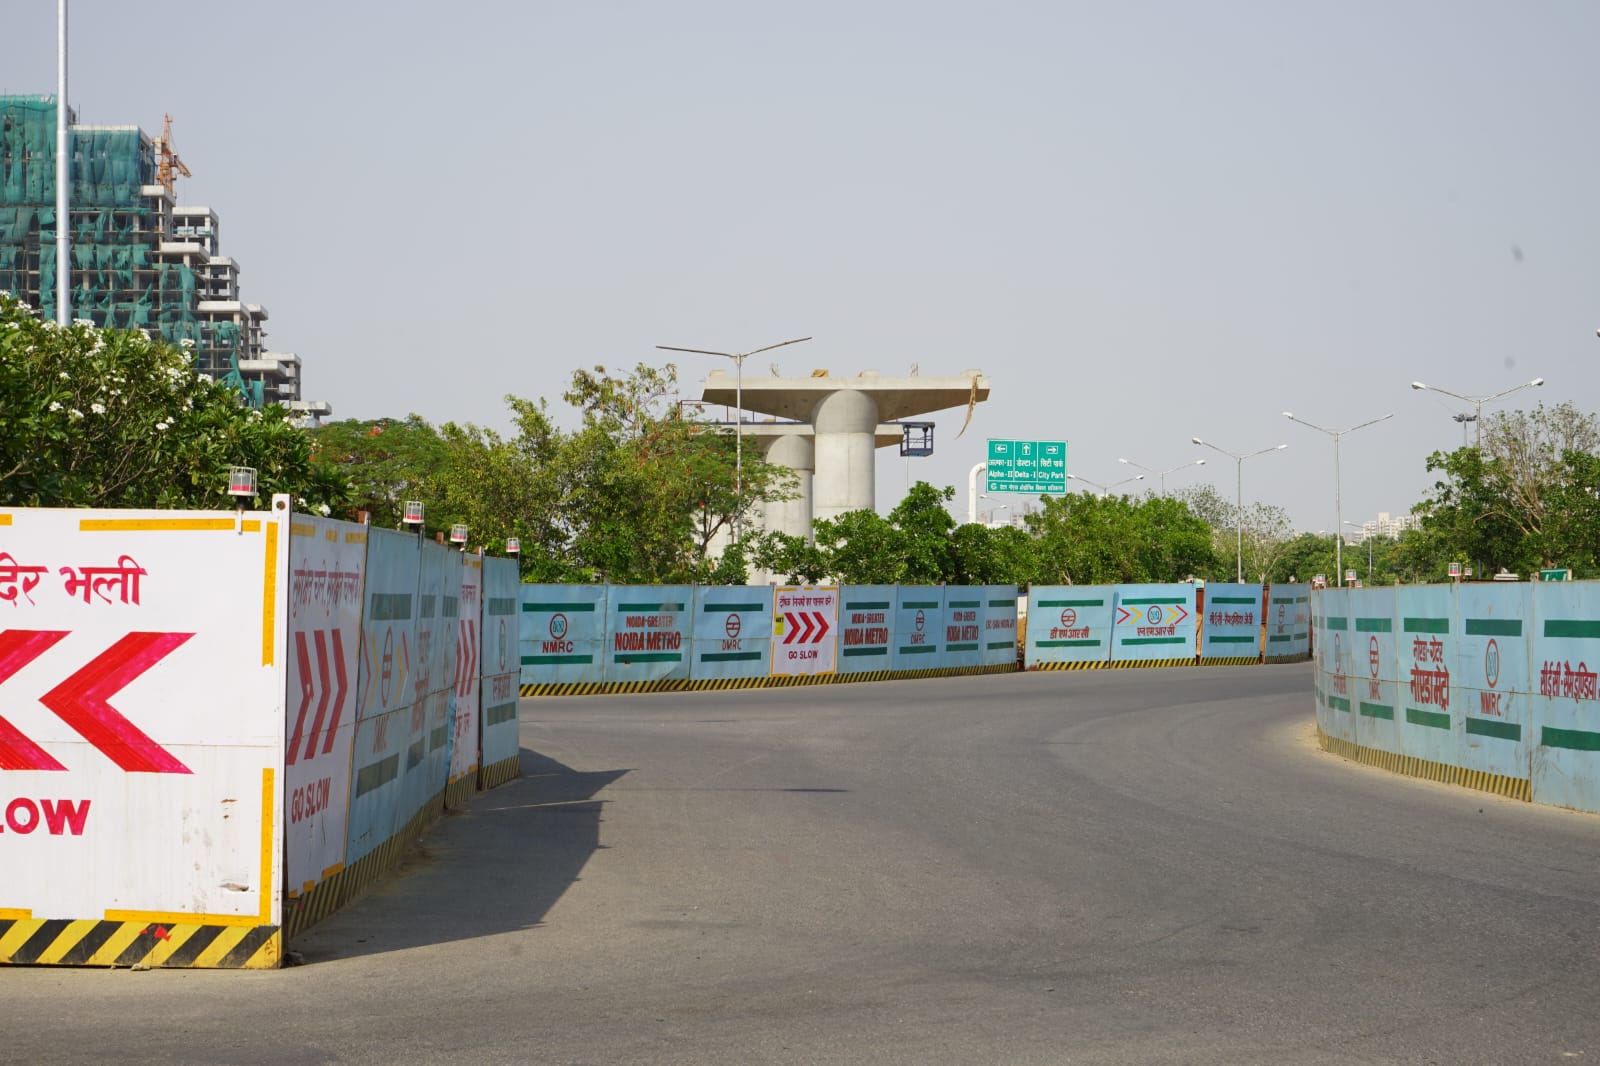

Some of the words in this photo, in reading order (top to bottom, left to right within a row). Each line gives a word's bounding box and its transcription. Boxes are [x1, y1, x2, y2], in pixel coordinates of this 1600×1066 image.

[1038, 471, 1050, 480] City
[1051, 471, 1064, 479] Park
[58, 555, 148, 606] भली
[614, 632, 644, 651] NOIDA
[646, 631, 681, 650] METRO
[722, 640, 742, 651] DMRC
[844, 628, 863, 646] NOIDA
[865, 627, 888, 644] METRO
[542, 641, 574, 654] NMRC
[788, 650, 798, 660] GO
[799, 650, 818, 660] SLOW
[1480, 691, 1502, 717] NMRC
[291, 786, 304, 825] GO
[305, 775, 332, 819] SLOW
[0, 797, 92, 836] OW
